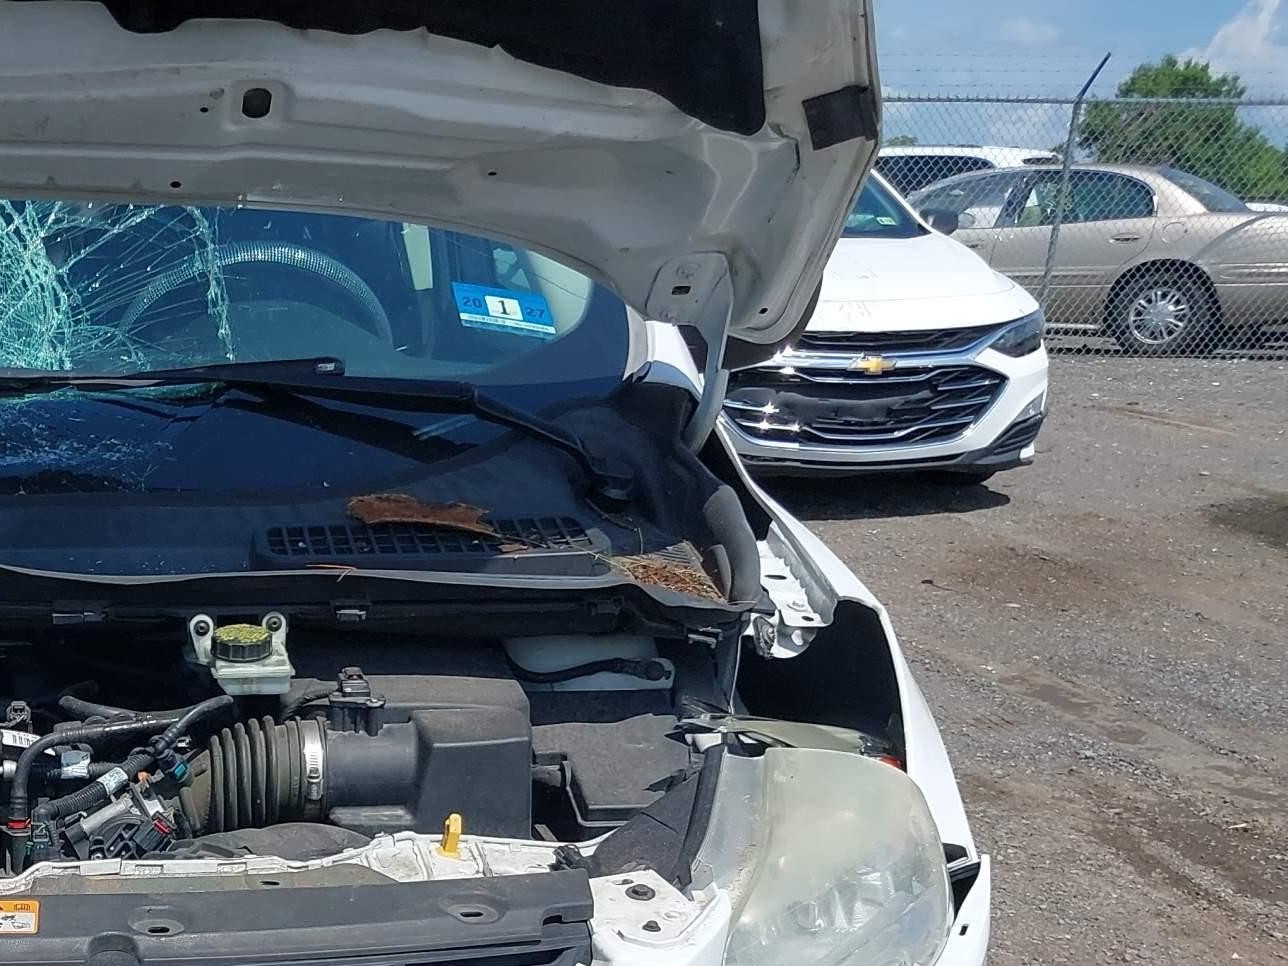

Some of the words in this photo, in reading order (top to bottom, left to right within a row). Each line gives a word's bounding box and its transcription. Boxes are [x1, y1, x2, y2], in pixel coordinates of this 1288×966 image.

[462, 296, 483, 308] 20
[497, 300, 510, 315] 1
[524, 306, 545, 319] 27
